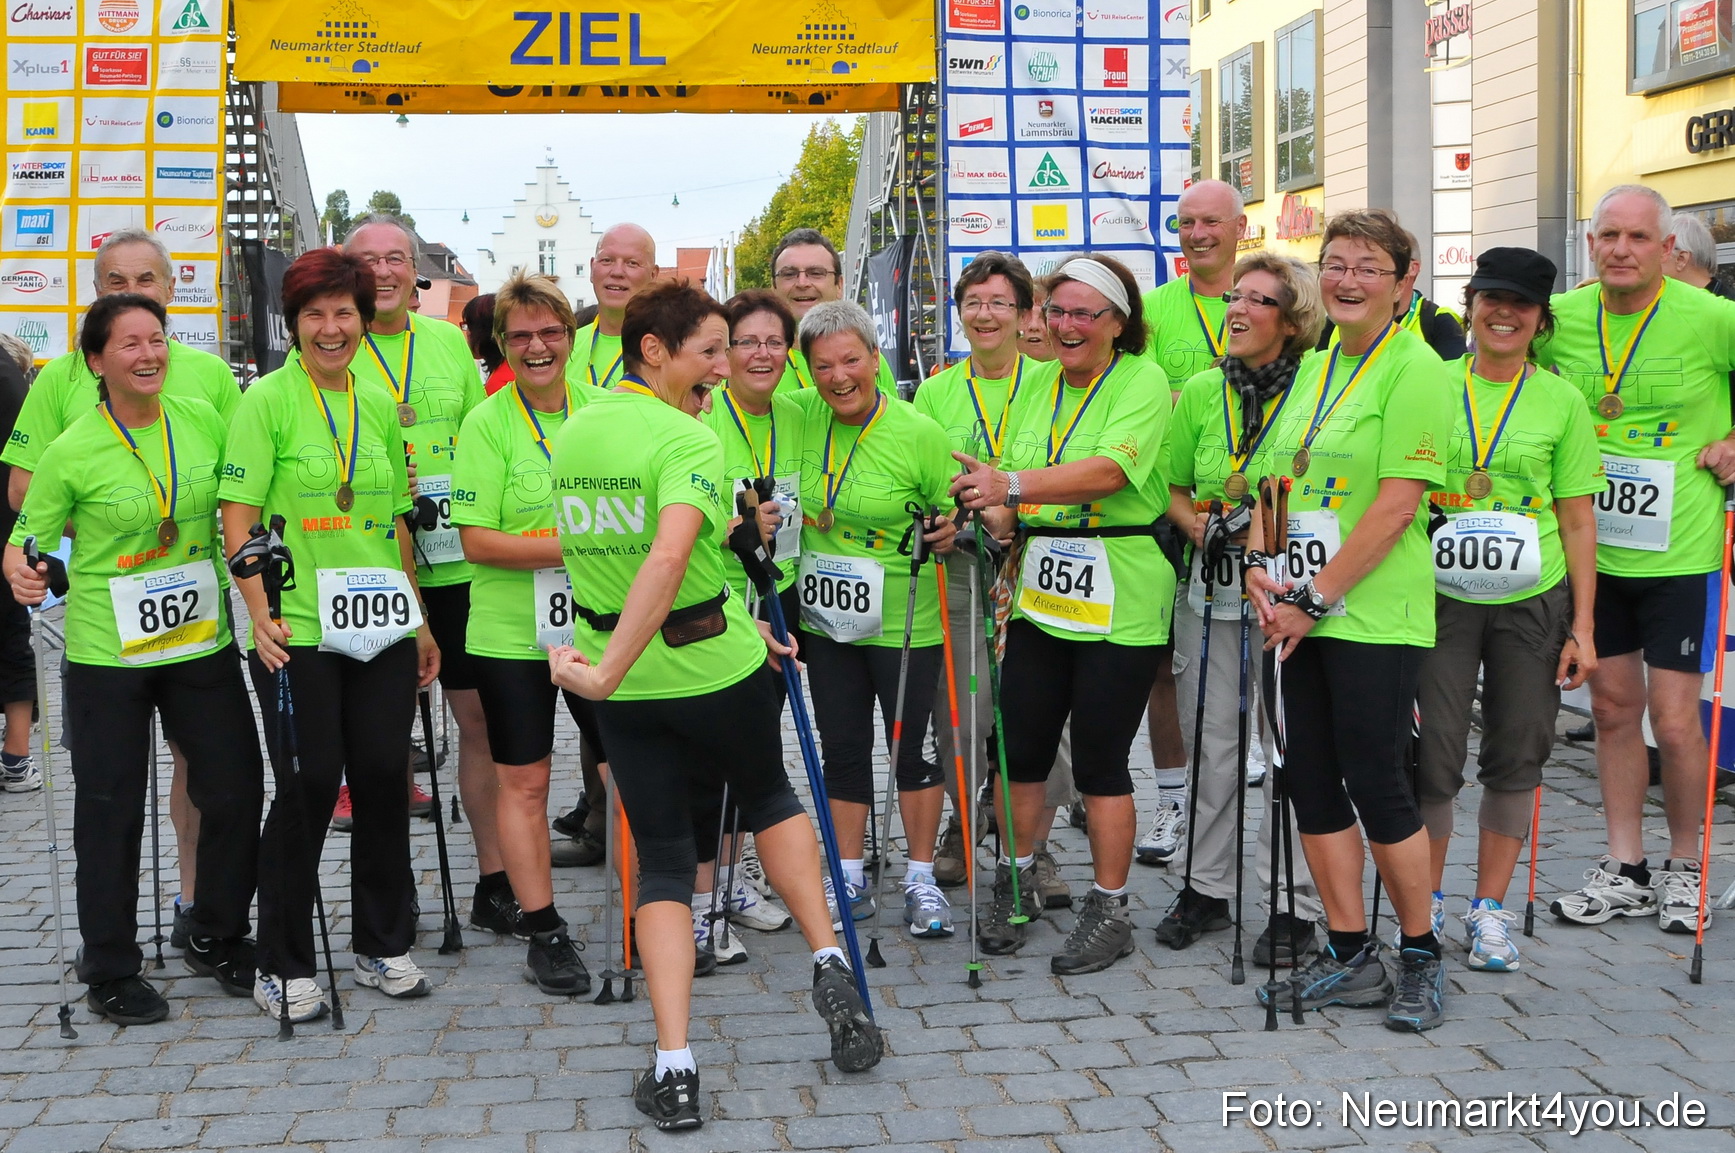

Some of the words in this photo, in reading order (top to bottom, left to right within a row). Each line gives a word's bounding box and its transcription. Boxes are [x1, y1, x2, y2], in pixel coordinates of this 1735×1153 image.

[11, 3, 73, 22] Charivari
[1033, 10, 1071, 18] Bionorica
[510, 12, 666, 65] ZIEL
[270, 39, 353, 52] Neumarkter
[358, 41, 422, 54] Stadtlauf
[752, 42, 832, 54] Neumarkter
[836, 42, 898, 55] Stadtlauf
[92, 52, 109, 60] GUT
[110, 50, 126, 60] FÜR
[128, 51, 142, 60] SIE!
[12, 60, 69, 76] Xplus1
[949, 58, 983, 69] swn
[1104, 70, 1126, 80] Braun
[177, 116, 214, 124] Bionorica
[1091, 116, 1142, 124] HACKNER
[26, 128, 54, 136] KANN
[1021, 129, 1073, 137] Lammsbräu
[13, 170, 64, 180] HACKNER
[1092, 161, 1146, 179] Charivari
[21, 213, 50, 228] maxi
[37, 236, 49, 244] dsl
[560, 477, 641, 490] ALPENVEREIN
[1303, 484, 1352, 496] Bretschneider
[562, 496, 645, 534] DAV
[1055, 512, 1106, 521] Bretschneider
[302, 516, 352, 531] MERZ
[1456, 518, 1503, 529] BOCK
[576, 546, 620, 556] Neumarkt
[622, 545, 640, 555] i.d.
[1051, 539, 1086, 553] BOCK
[117, 546, 169, 568] MERZ
[1436, 536, 1525, 570] 8067
[817, 559, 852, 572] BOCK
[145, 571, 185, 588] BOCK
[347, 574, 387, 585] BOCK
[1038, 556, 1094, 599] 854
[1450, 576, 1498, 591] Monika
[804, 574, 870, 613] 8068
[138, 589, 199, 633] 862
[332, 592, 409, 629] 8099
